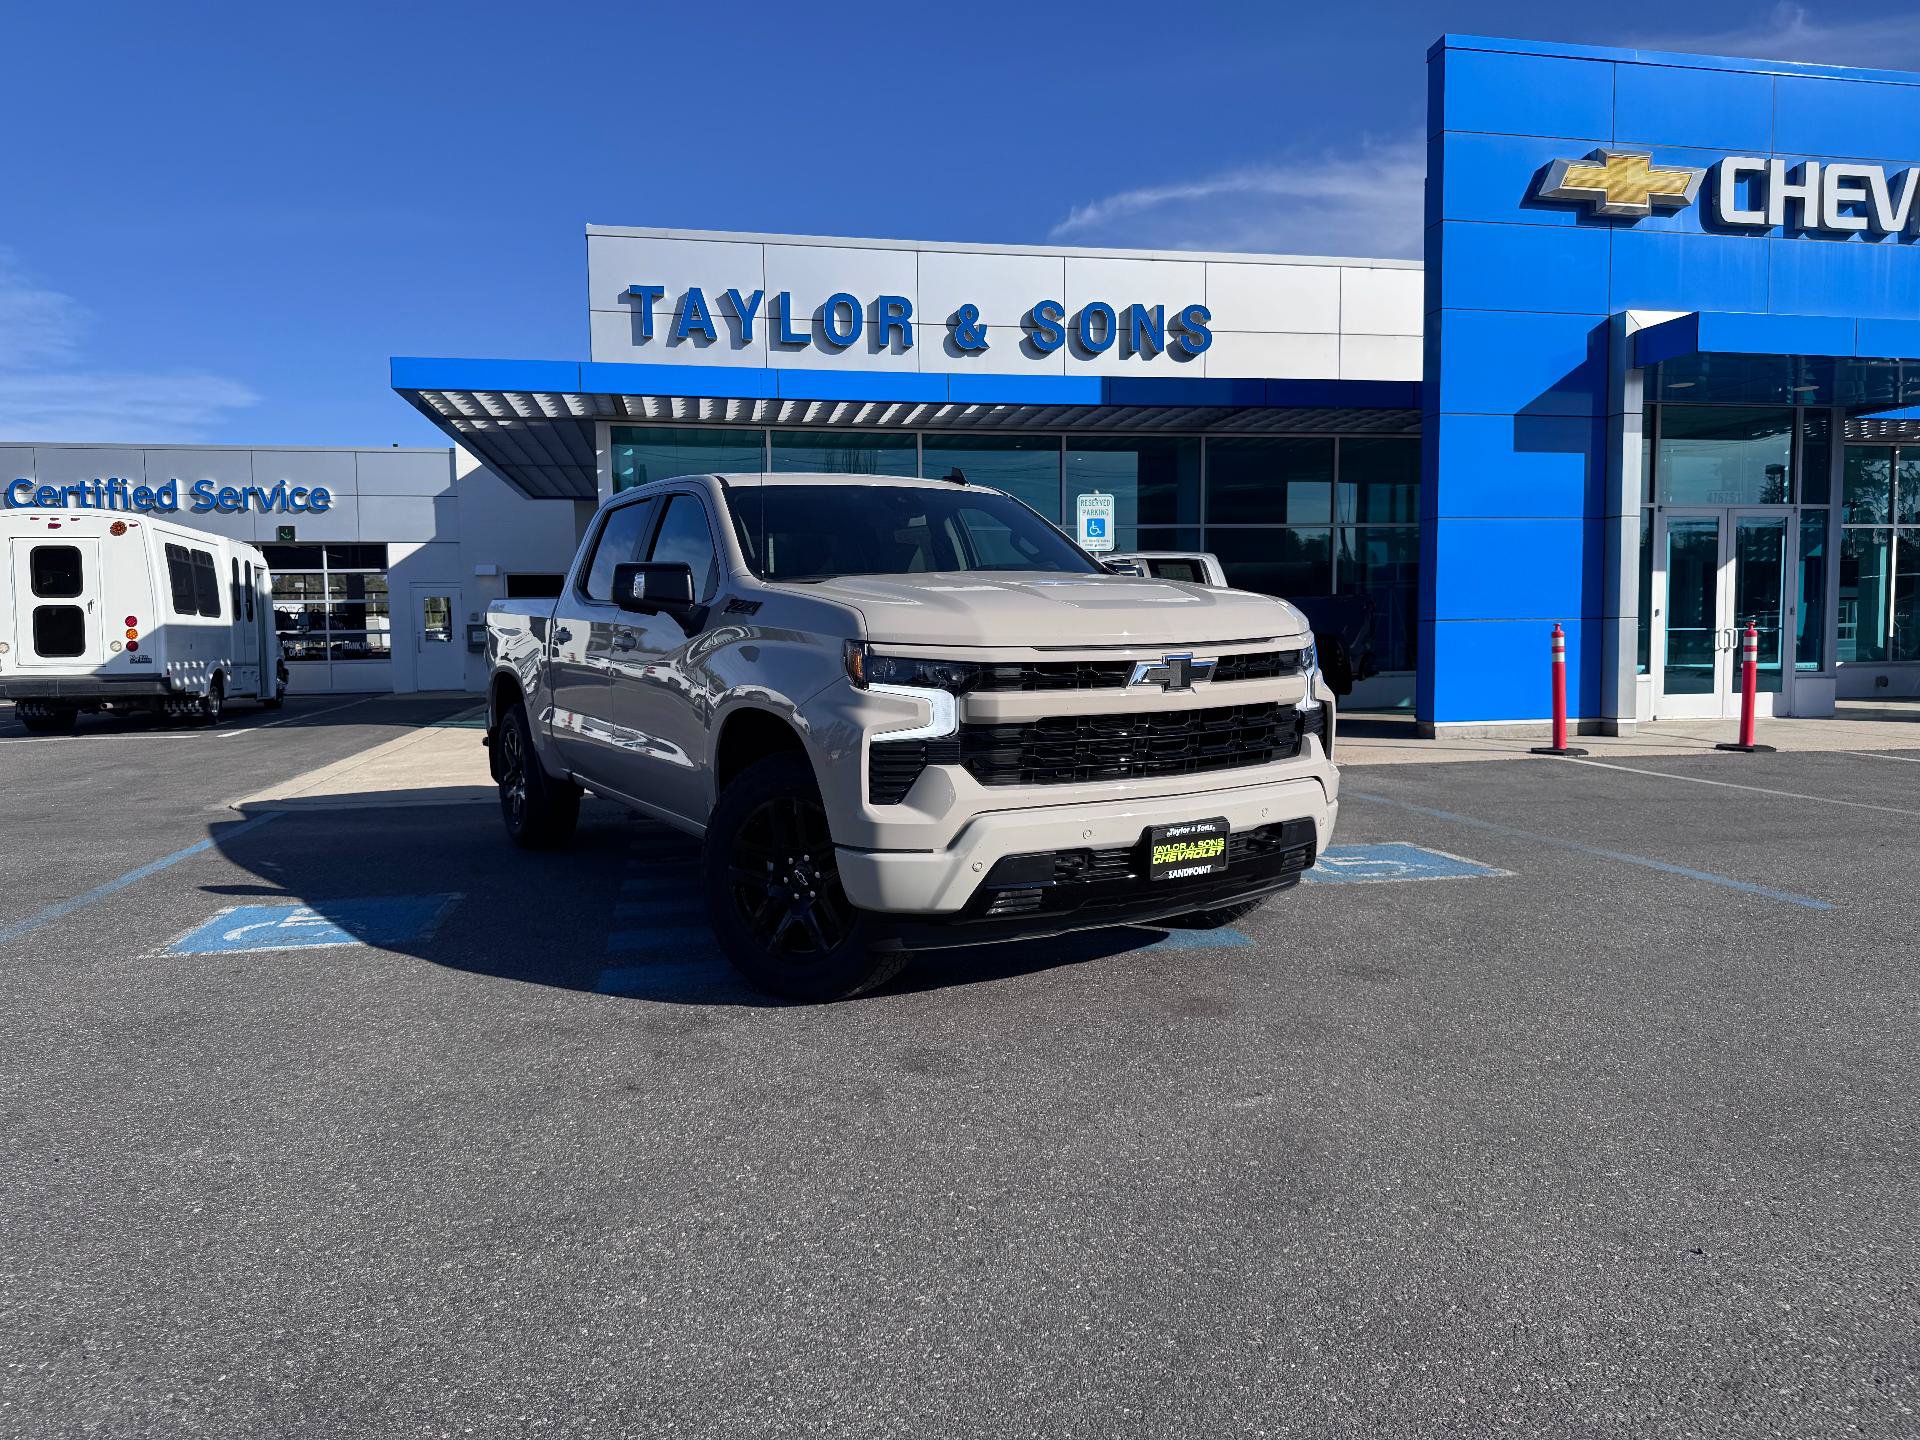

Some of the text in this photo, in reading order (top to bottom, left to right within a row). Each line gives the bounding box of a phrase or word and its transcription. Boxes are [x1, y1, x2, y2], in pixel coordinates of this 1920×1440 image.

[1720, 156, 1920, 233] CHEV
[628, 284, 1214, 356] TAYLOR & SONS
[8, 477, 332, 511] Certified Service
[1080, 499, 1111, 507] RESERVED
[1082, 508, 1109, 516] PARKING
[289, 648, 305, 657] OPEN
[1169, 827, 1190, 837] Taylor
[1153, 837, 1225, 854] TAYLOR & SONS
[1152, 847, 1225, 865] CHEVROLET
[1168, 864, 1212, 879] SANDPOINT
